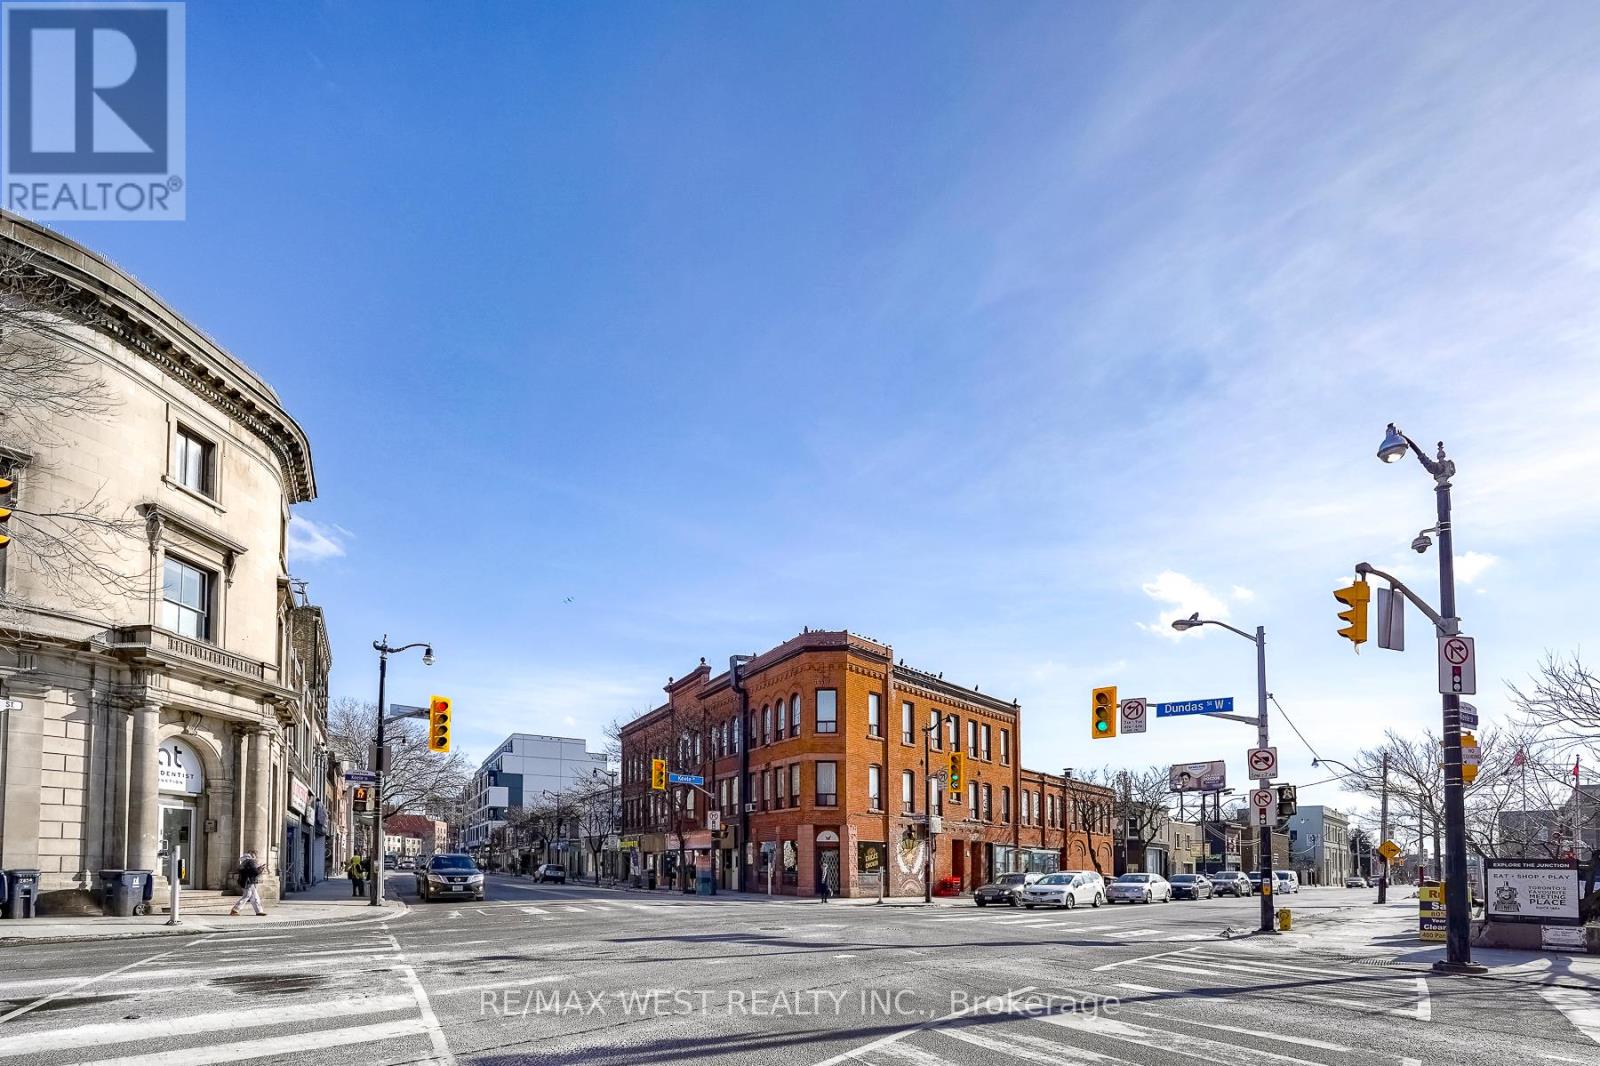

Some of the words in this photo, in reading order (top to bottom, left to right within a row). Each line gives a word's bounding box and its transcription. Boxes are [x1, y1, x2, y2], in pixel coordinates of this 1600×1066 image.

[1164, 702, 1204, 714] Dundas
[1214, 699, 1224, 710] W
[160, 770, 195, 779] DENTIST
